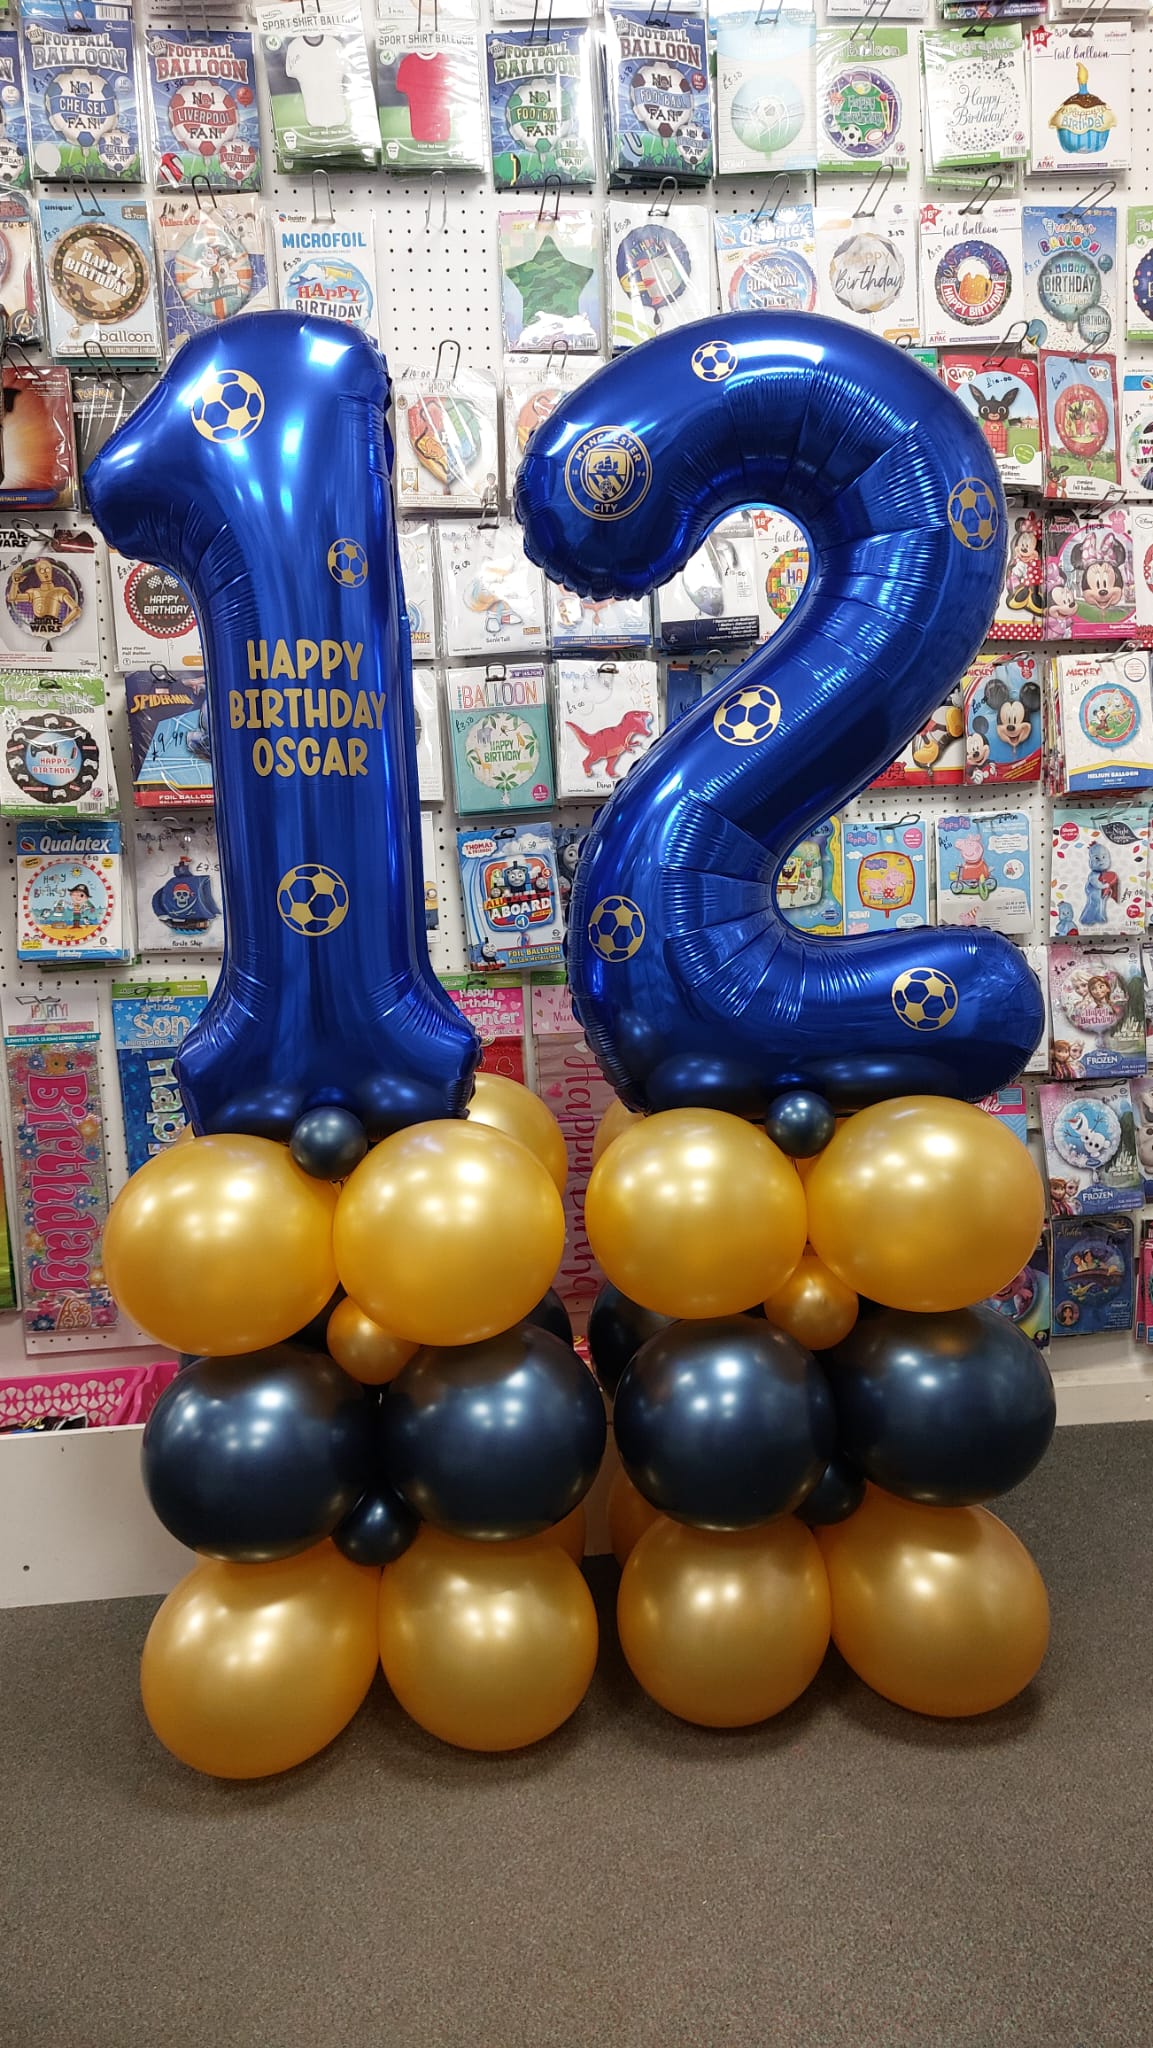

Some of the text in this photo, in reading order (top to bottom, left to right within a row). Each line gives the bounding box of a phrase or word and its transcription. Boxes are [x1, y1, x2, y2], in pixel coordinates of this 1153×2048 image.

[262, 16, 318, 30] SPORT SHIRT
[379, 34, 433, 45] SPORT SHIRT
[629, 22, 689, 43] FOOTBALL
[1034, 32, 1049, 42] 18"
[44, 33, 112, 47] FOOTBALL
[166, 44, 233, 59] FOOTBALL
[506, 42, 569, 57] FOOTBALL
[620, 39, 701, 68] BALLOON
[1054, 45, 1110, 60] foil balloon
[33, 46, 128, 71] BALLOON
[156, 57, 249, 83] BALLOON
[495, 56, 581, 82] BALLOON
[640, 90, 690, 108] FOOTBALL
[959, 84, 1005, 107] Happy
[59, 97, 107, 116] CHELSEA
[176, 109, 232, 124] LIVERPOOL
[649, 110, 683, 121] FAN!
[67, 117, 101, 130] FAN!
[189, 128, 223, 139] FAN!
[104, 145, 134, 154] CHELSEA
[1037, 160, 1054, 168] APAC
[942, 221, 999, 238] foil balloon
[1043, 218, 1096, 235] Greetings
[282, 233, 367, 248] MICROFOIL
[1039, 235, 1101, 256] BALLOON
[81, 250, 124, 278] HAPPY
[65, 257, 132, 297] BIRTHDAY
[835, 264, 903, 293] Birthday
[1044, 275, 1095, 293] BIRTHDAY
[296, 283, 360, 302] HAPPY
[942, 283, 1005, 317] HAPPY BIRTHDAY
[295, 299, 363, 317] BIRTHDAY
[1079, 314, 1109, 325] BIRTHDAY
[98, 329, 154, 343] balloon
[948, 368, 974, 381] Bing
[1089, 366, 1109, 379] Bing
[593, 503, 618, 513] CITY
[756, 517, 767, 526] 18"
[774, 533, 790, 543] foil
[150, 595, 179, 604] HAPPY
[143, 606, 190, 615] BIRTHDAY
[30, 625, 63, 633] WARS
[80, 659, 97, 667] Disney
[246, 639, 364, 681] HAPPY
[965, 668, 995, 676] MICKEY
[1066, 667, 1100, 676] MICKEY
[3, 687, 96, 707] Holographic
[462, 681, 538, 708] BALLOON
[59, 706, 95, 714] Balloon
[130, 693, 194, 713] SPIDER-MAN
[228, 688, 386, 730] BIRTHDAY
[489, 741, 514, 753] HAPPY
[252, 736, 368, 777] OSCAR
[484, 750, 522, 762] BIRTHDAY
[1111, 770, 1139, 778] BALLOON
[938, 817, 970, 830] Peppa Pig
[1113, 827, 1129, 836] Night
[40, 836, 112, 853] Qualatex
[847, 833, 877, 846] Peppa Pig
[465, 843, 493, 851] THOMAS
[491, 897, 551, 919] ABOARD
[527, 946, 560, 956] BALLOON
[459, 988, 495, 998] Happy
[1085, 1008, 1108, 1017] Happy
[133, 1014, 192, 1039] Son
[1080, 1016, 1113, 1025] Birthday
[1087, 1056, 1118, 1064] FROZEN
[26, 1072, 97, 1292] Birthday
[1082, 1191, 1113, 1201] FROZEN
